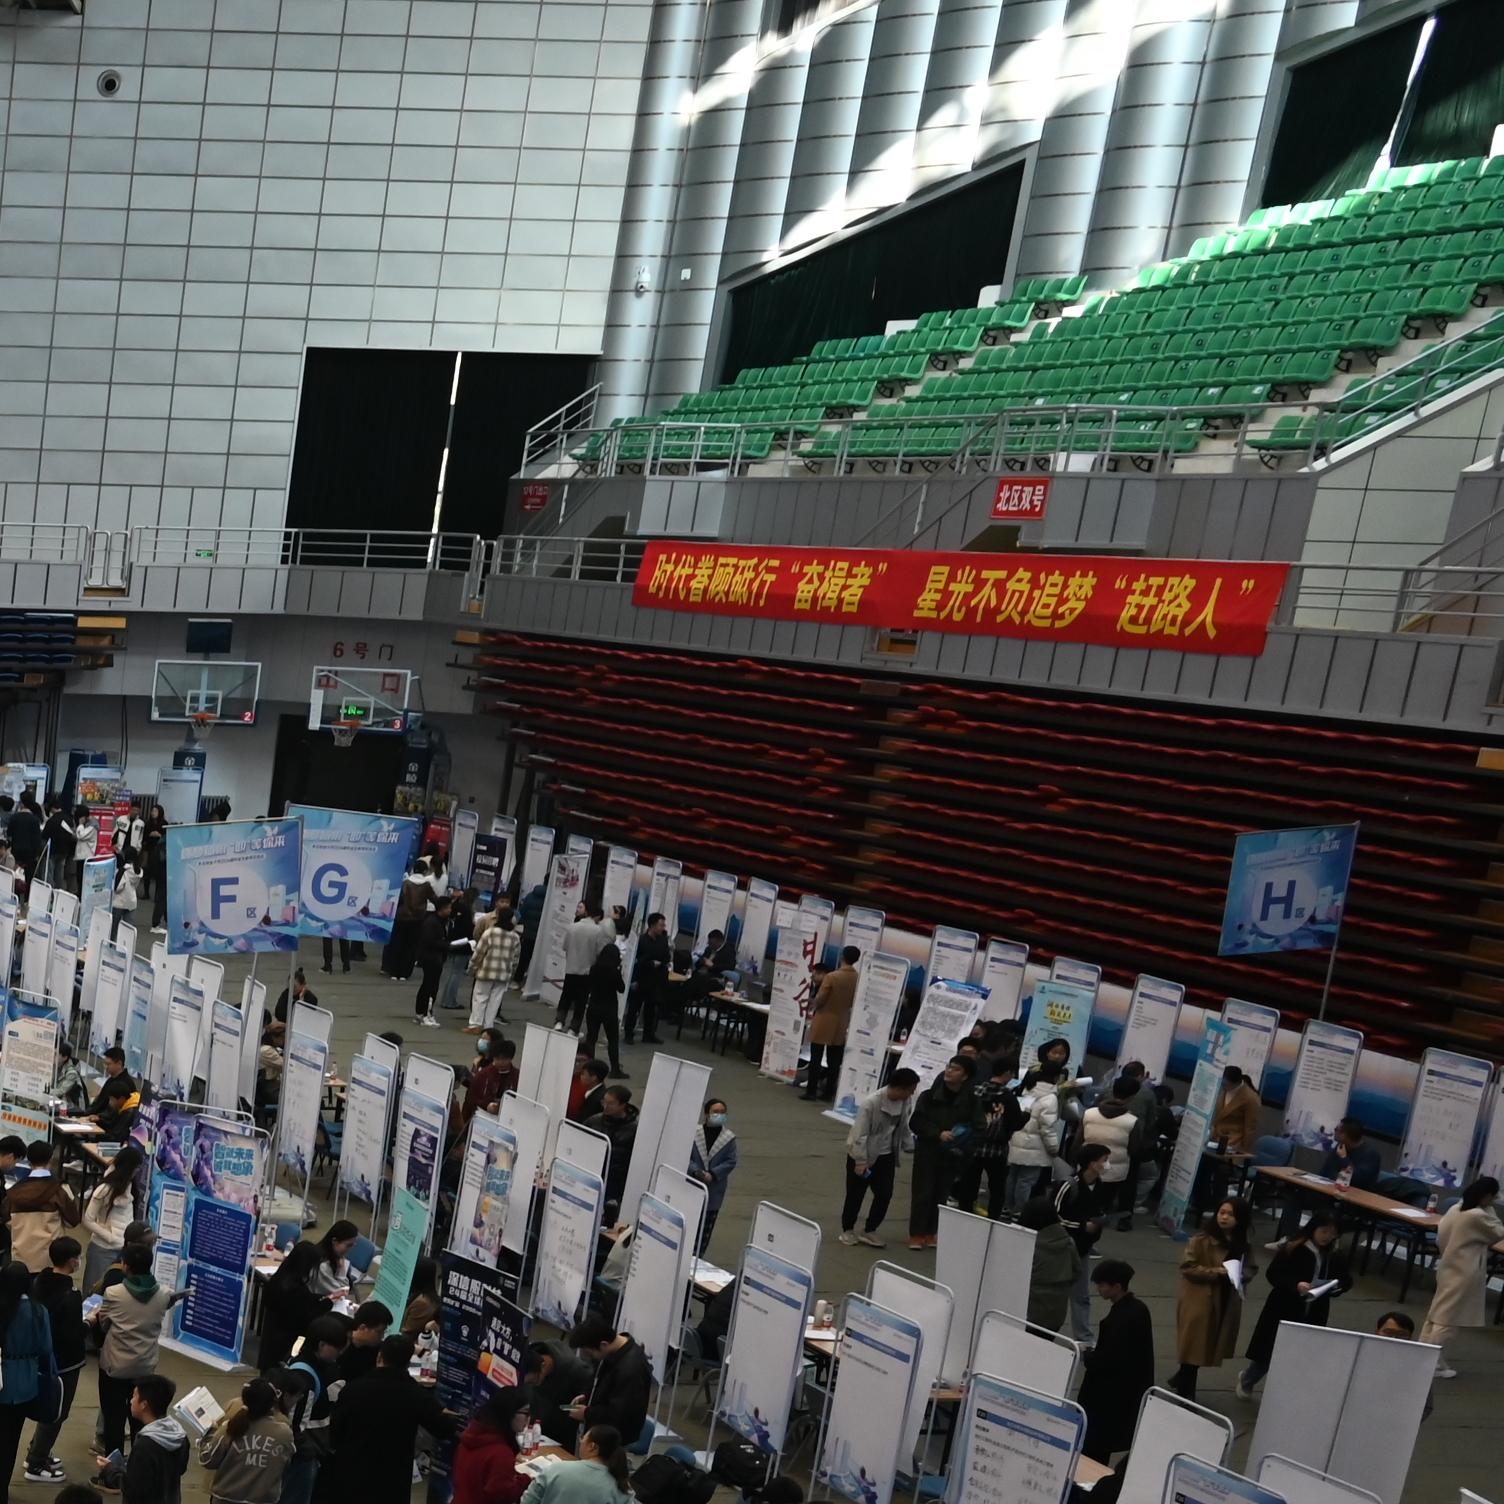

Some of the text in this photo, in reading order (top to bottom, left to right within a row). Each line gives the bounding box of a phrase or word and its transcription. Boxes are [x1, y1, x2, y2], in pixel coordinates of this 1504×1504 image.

[996, 484, 1045, 512] 北区双号
[333, 641, 395, 661] 6号门
[243, 711, 252, 721] 2
[393, 719, 401, 730] 3
[231, 1434, 281, 1457] LIKES
[245, 1453, 268, 1468] ME
